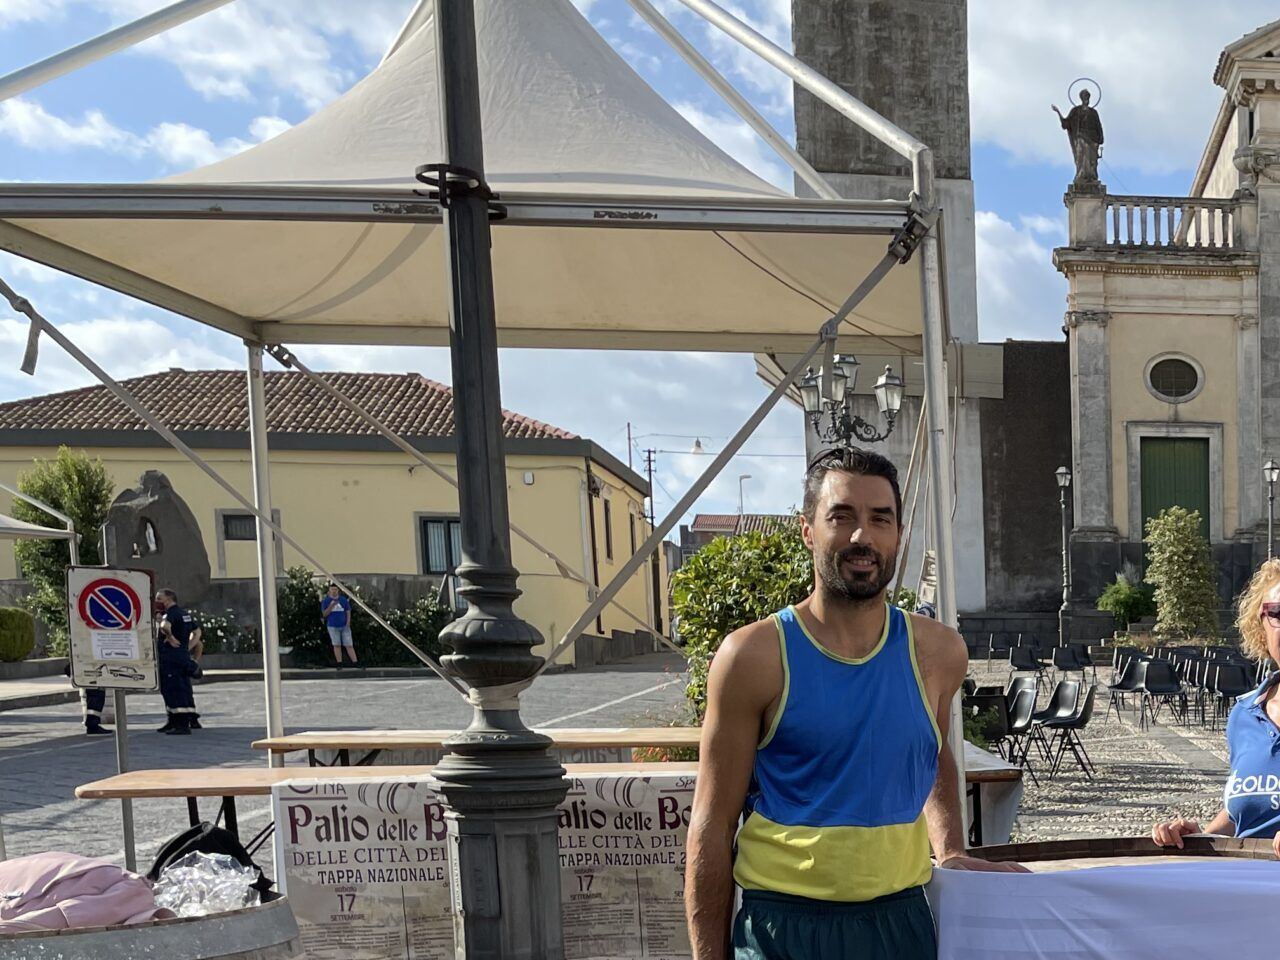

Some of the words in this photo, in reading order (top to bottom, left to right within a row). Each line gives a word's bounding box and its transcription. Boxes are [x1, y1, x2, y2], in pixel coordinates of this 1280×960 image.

[288, 803, 370, 844] Palio
[377, 818, 418, 841] delle
[558, 799, 607, 829] alio
[614, 811, 653, 830] delle
[559, 836, 587, 848] LLE
[592, 834, 645, 849] CITTÀ
[651, 835, 682, 847] DEL
[293, 851, 348, 866] DELLE
[354, 845, 410, 863] CITTÀ
[417, 848, 449, 862] DEL
[559, 853, 600, 867] TAPPA
[605, 851, 676, 866] NAZIONALE
[318, 869, 363, 884] TAPPA
[368, 867, 444, 882] NAZIONALE
[577, 874, 594, 891] 17
[337, 893, 357, 912] 17
